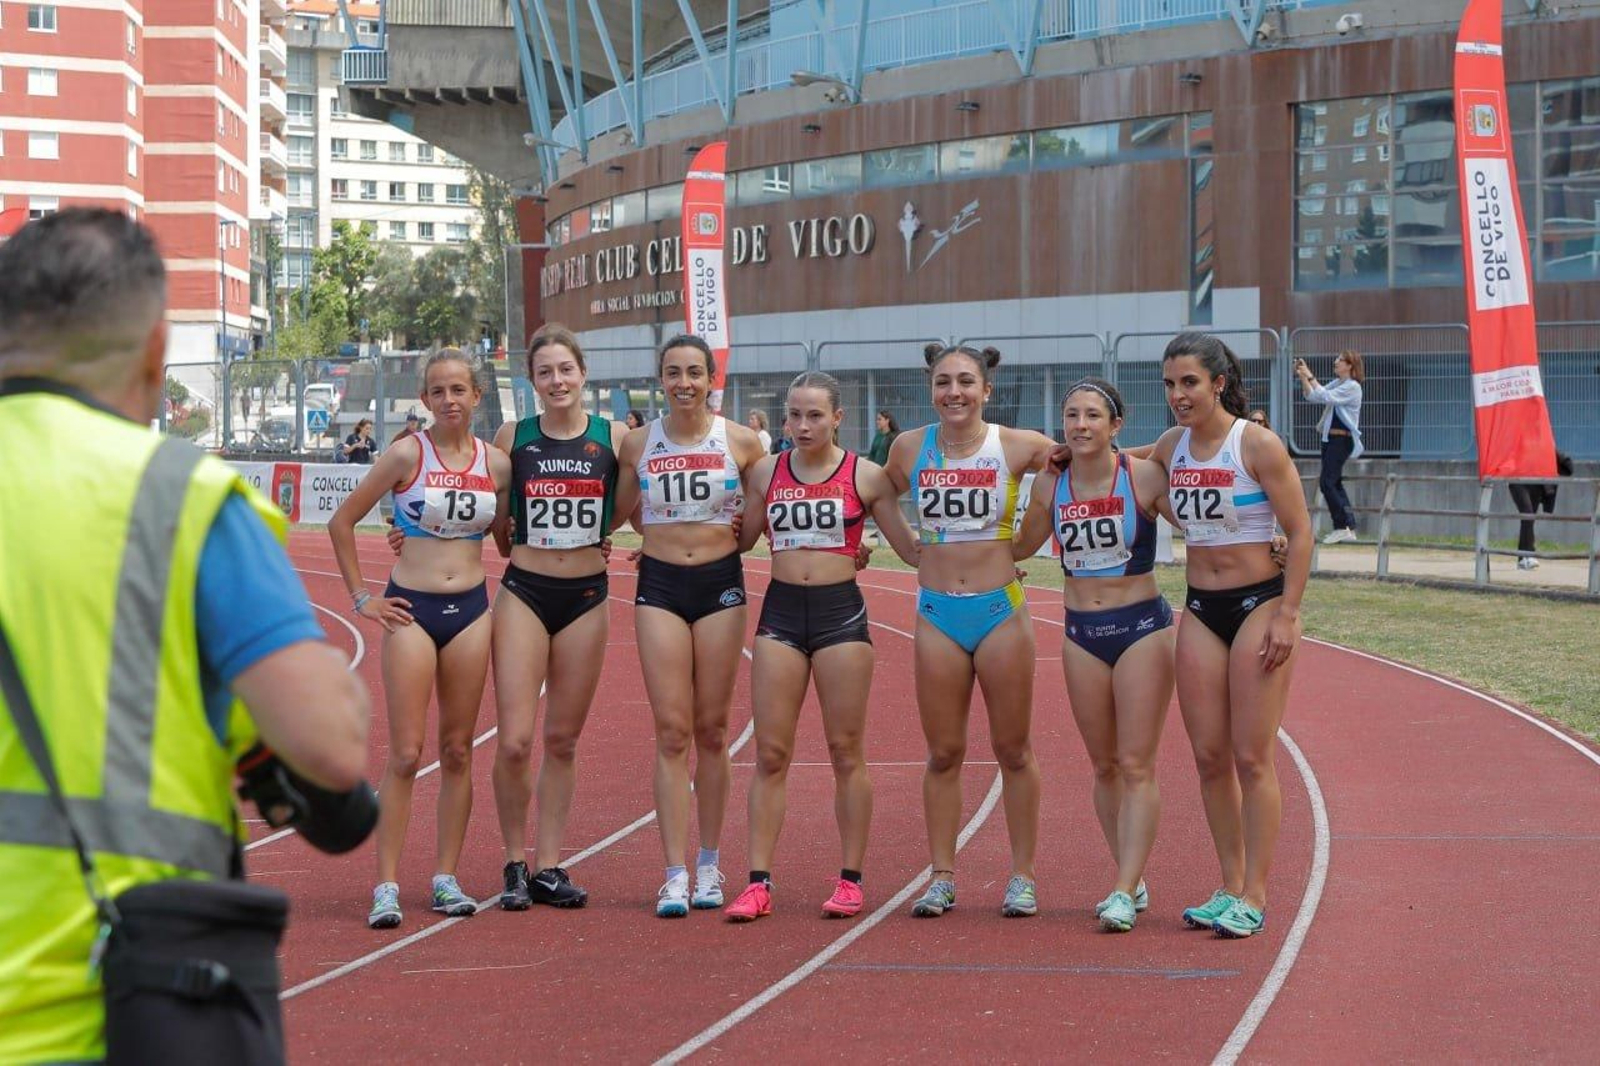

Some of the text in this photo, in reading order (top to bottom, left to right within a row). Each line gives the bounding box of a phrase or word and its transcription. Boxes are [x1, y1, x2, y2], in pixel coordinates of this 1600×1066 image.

[1474, 170, 1496, 297] CONCELLO
[1490, 185, 1511, 280] DE VIGO
[564, 254, 588, 291] REAL
[595, 244, 636, 283] CLUB
[646, 236, 685, 276] CEL
[732, 224, 767, 265] DE
[788, 213, 873, 259] VIGO
[607, 296, 631, 312] SOCIAL
[706, 267, 718, 333] DE VIGO
[537, 459, 592, 475] XUNCAS
[650, 457, 687, 472] VIGO
[921, 472, 994, 486] VIGO 2024
[1173, 471, 1201, 485] VIGO
[312, 477, 358, 491] CONCEL
[427, 474, 462, 487] VIGO
[528, 483, 567, 495] VIGO
[658, 470, 711, 503] 116
[318, 496, 333, 511] DE
[444, 490, 477, 521] 13
[530, 498, 597, 529] 286
[769, 500, 837, 532] 208
[922, 488, 989, 518] 260
[1174, 488, 1224, 520] 212
[1061, 518, 1118, 553] 219
